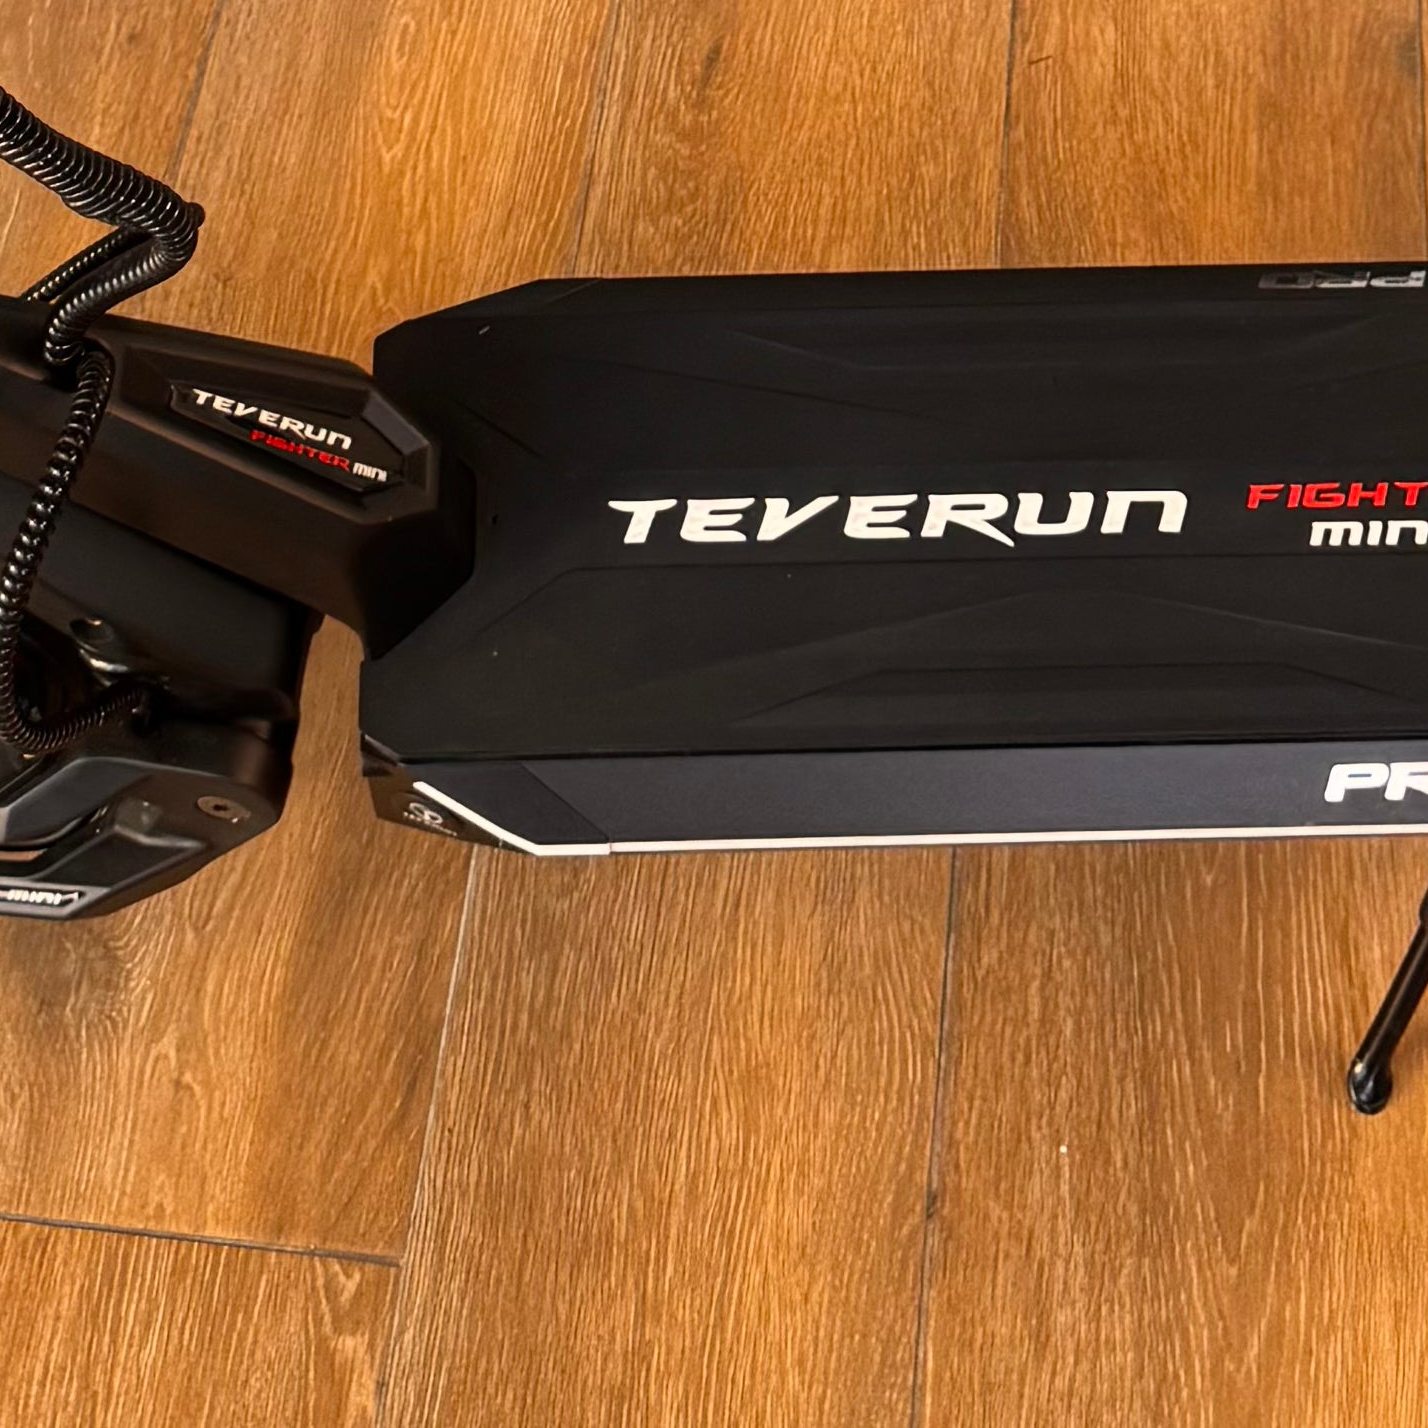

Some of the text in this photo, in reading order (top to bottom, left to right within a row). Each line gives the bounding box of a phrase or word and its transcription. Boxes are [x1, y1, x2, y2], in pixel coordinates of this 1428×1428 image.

[1258, 270, 1426, 289] PRO
[192, 388, 352, 450] TEVERUN
[249, 428, 387, 482] FIGHTER MINI
[606, 489, 1188, 549] TEVERUN
